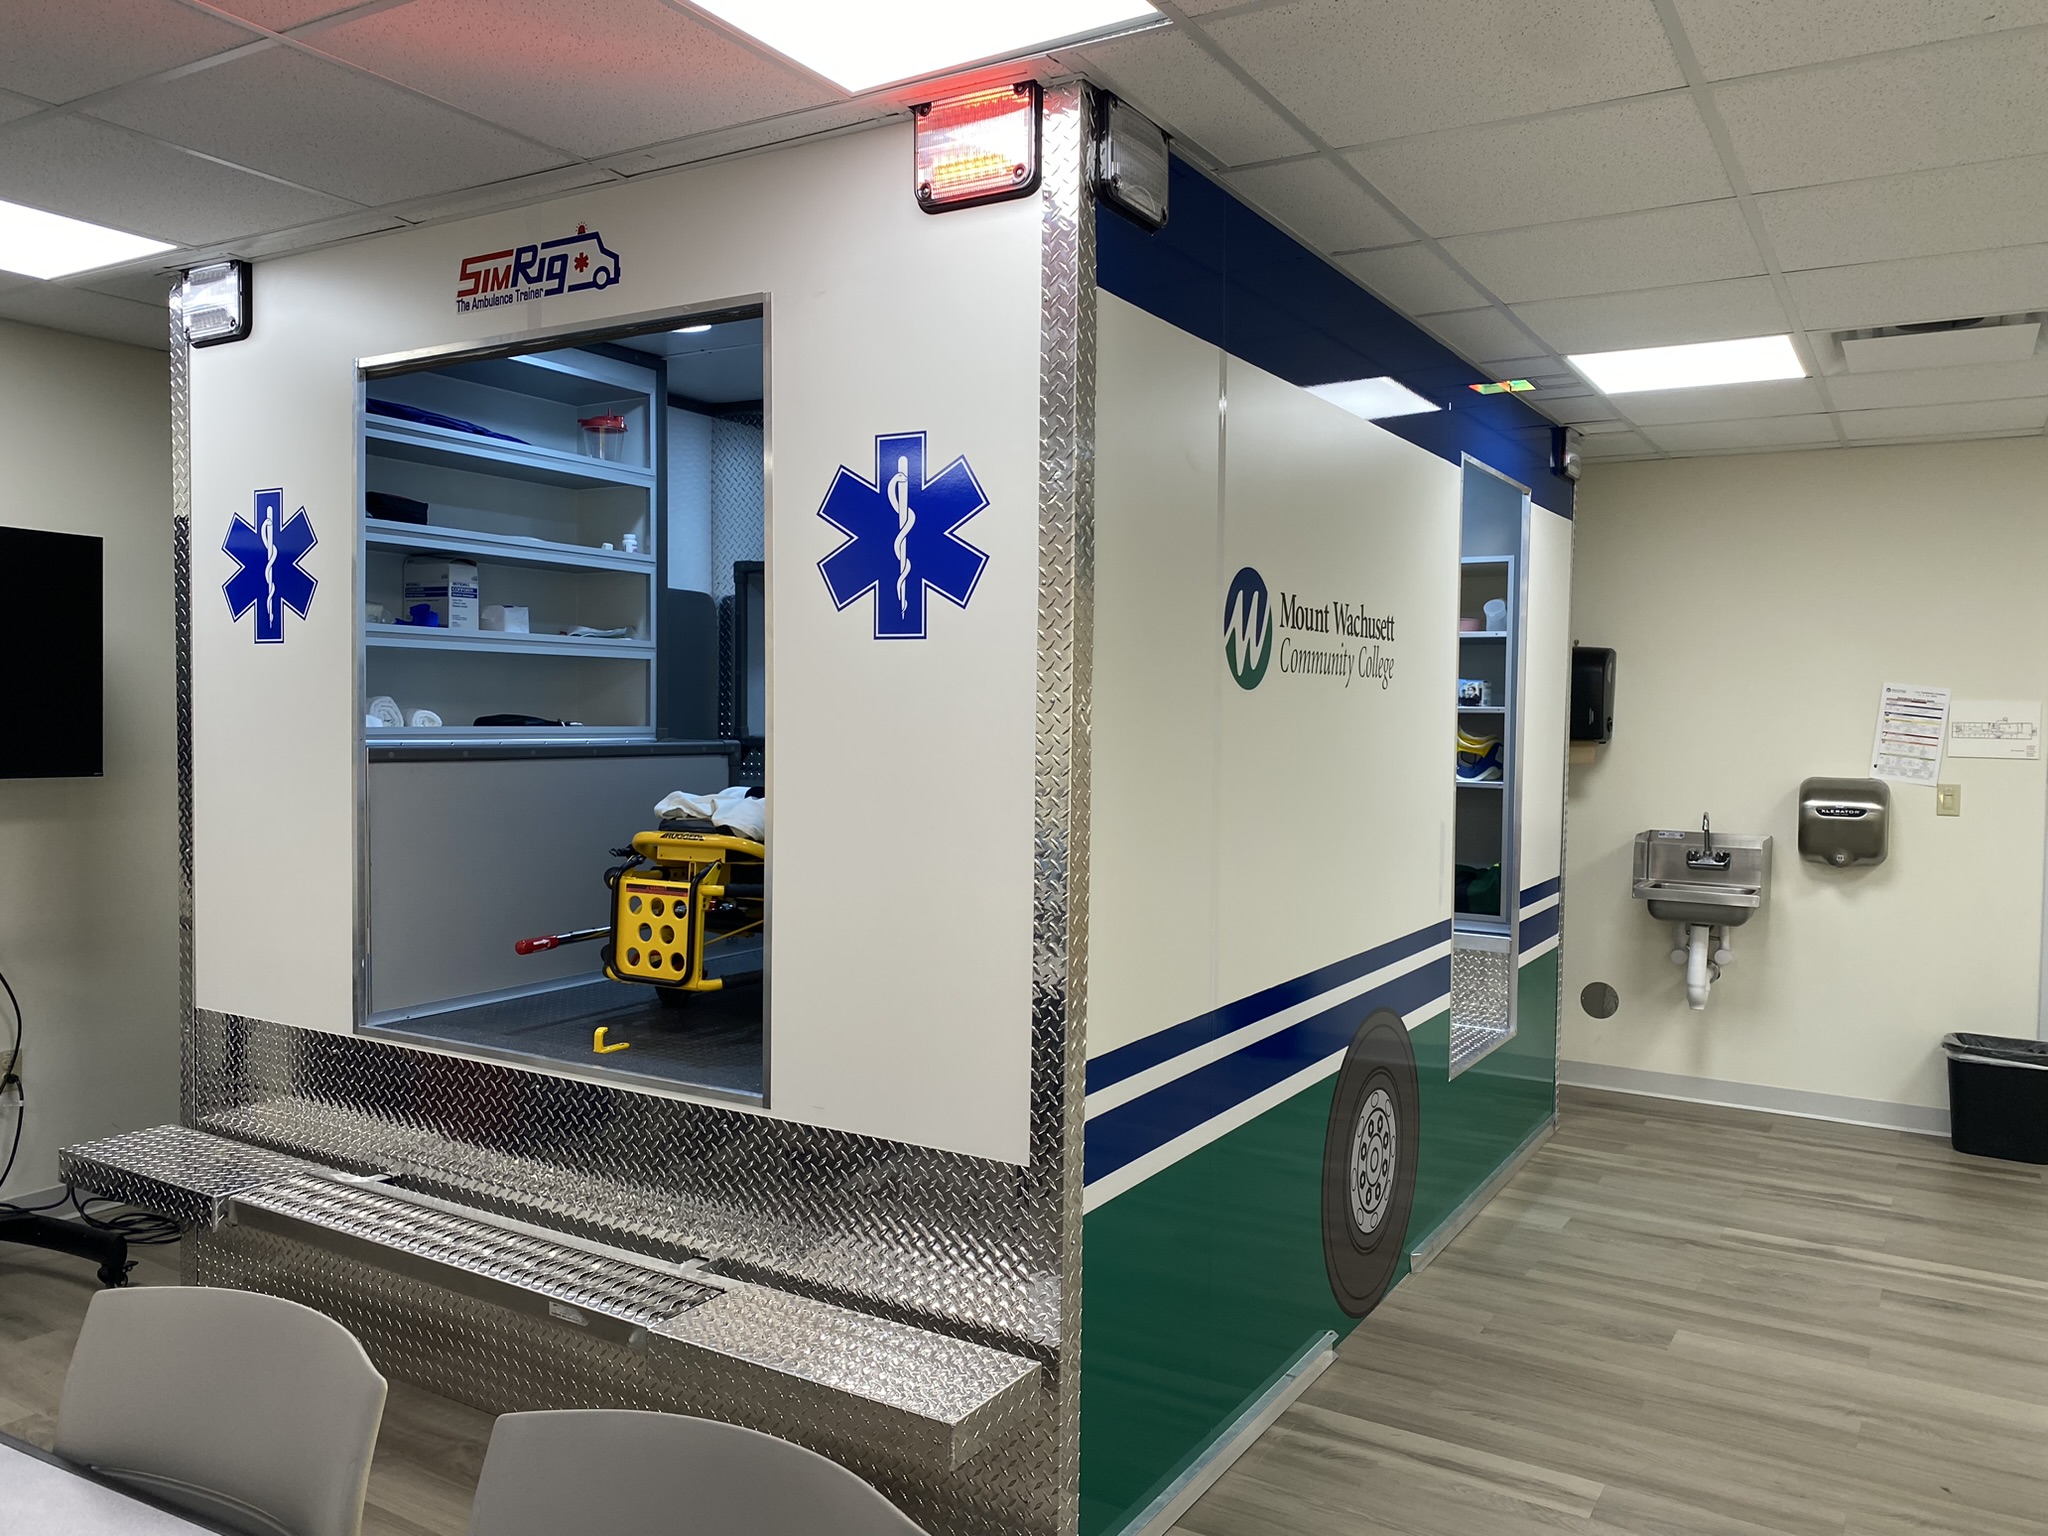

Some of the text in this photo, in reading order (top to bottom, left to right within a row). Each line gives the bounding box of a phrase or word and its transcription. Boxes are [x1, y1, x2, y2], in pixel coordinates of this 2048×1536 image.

[456, 288, 544, 313] The Ambulance Trainer
[1279, 592, 1395, 642] Mount Wachusett
[1280, 637, 1395, 690] Community College
